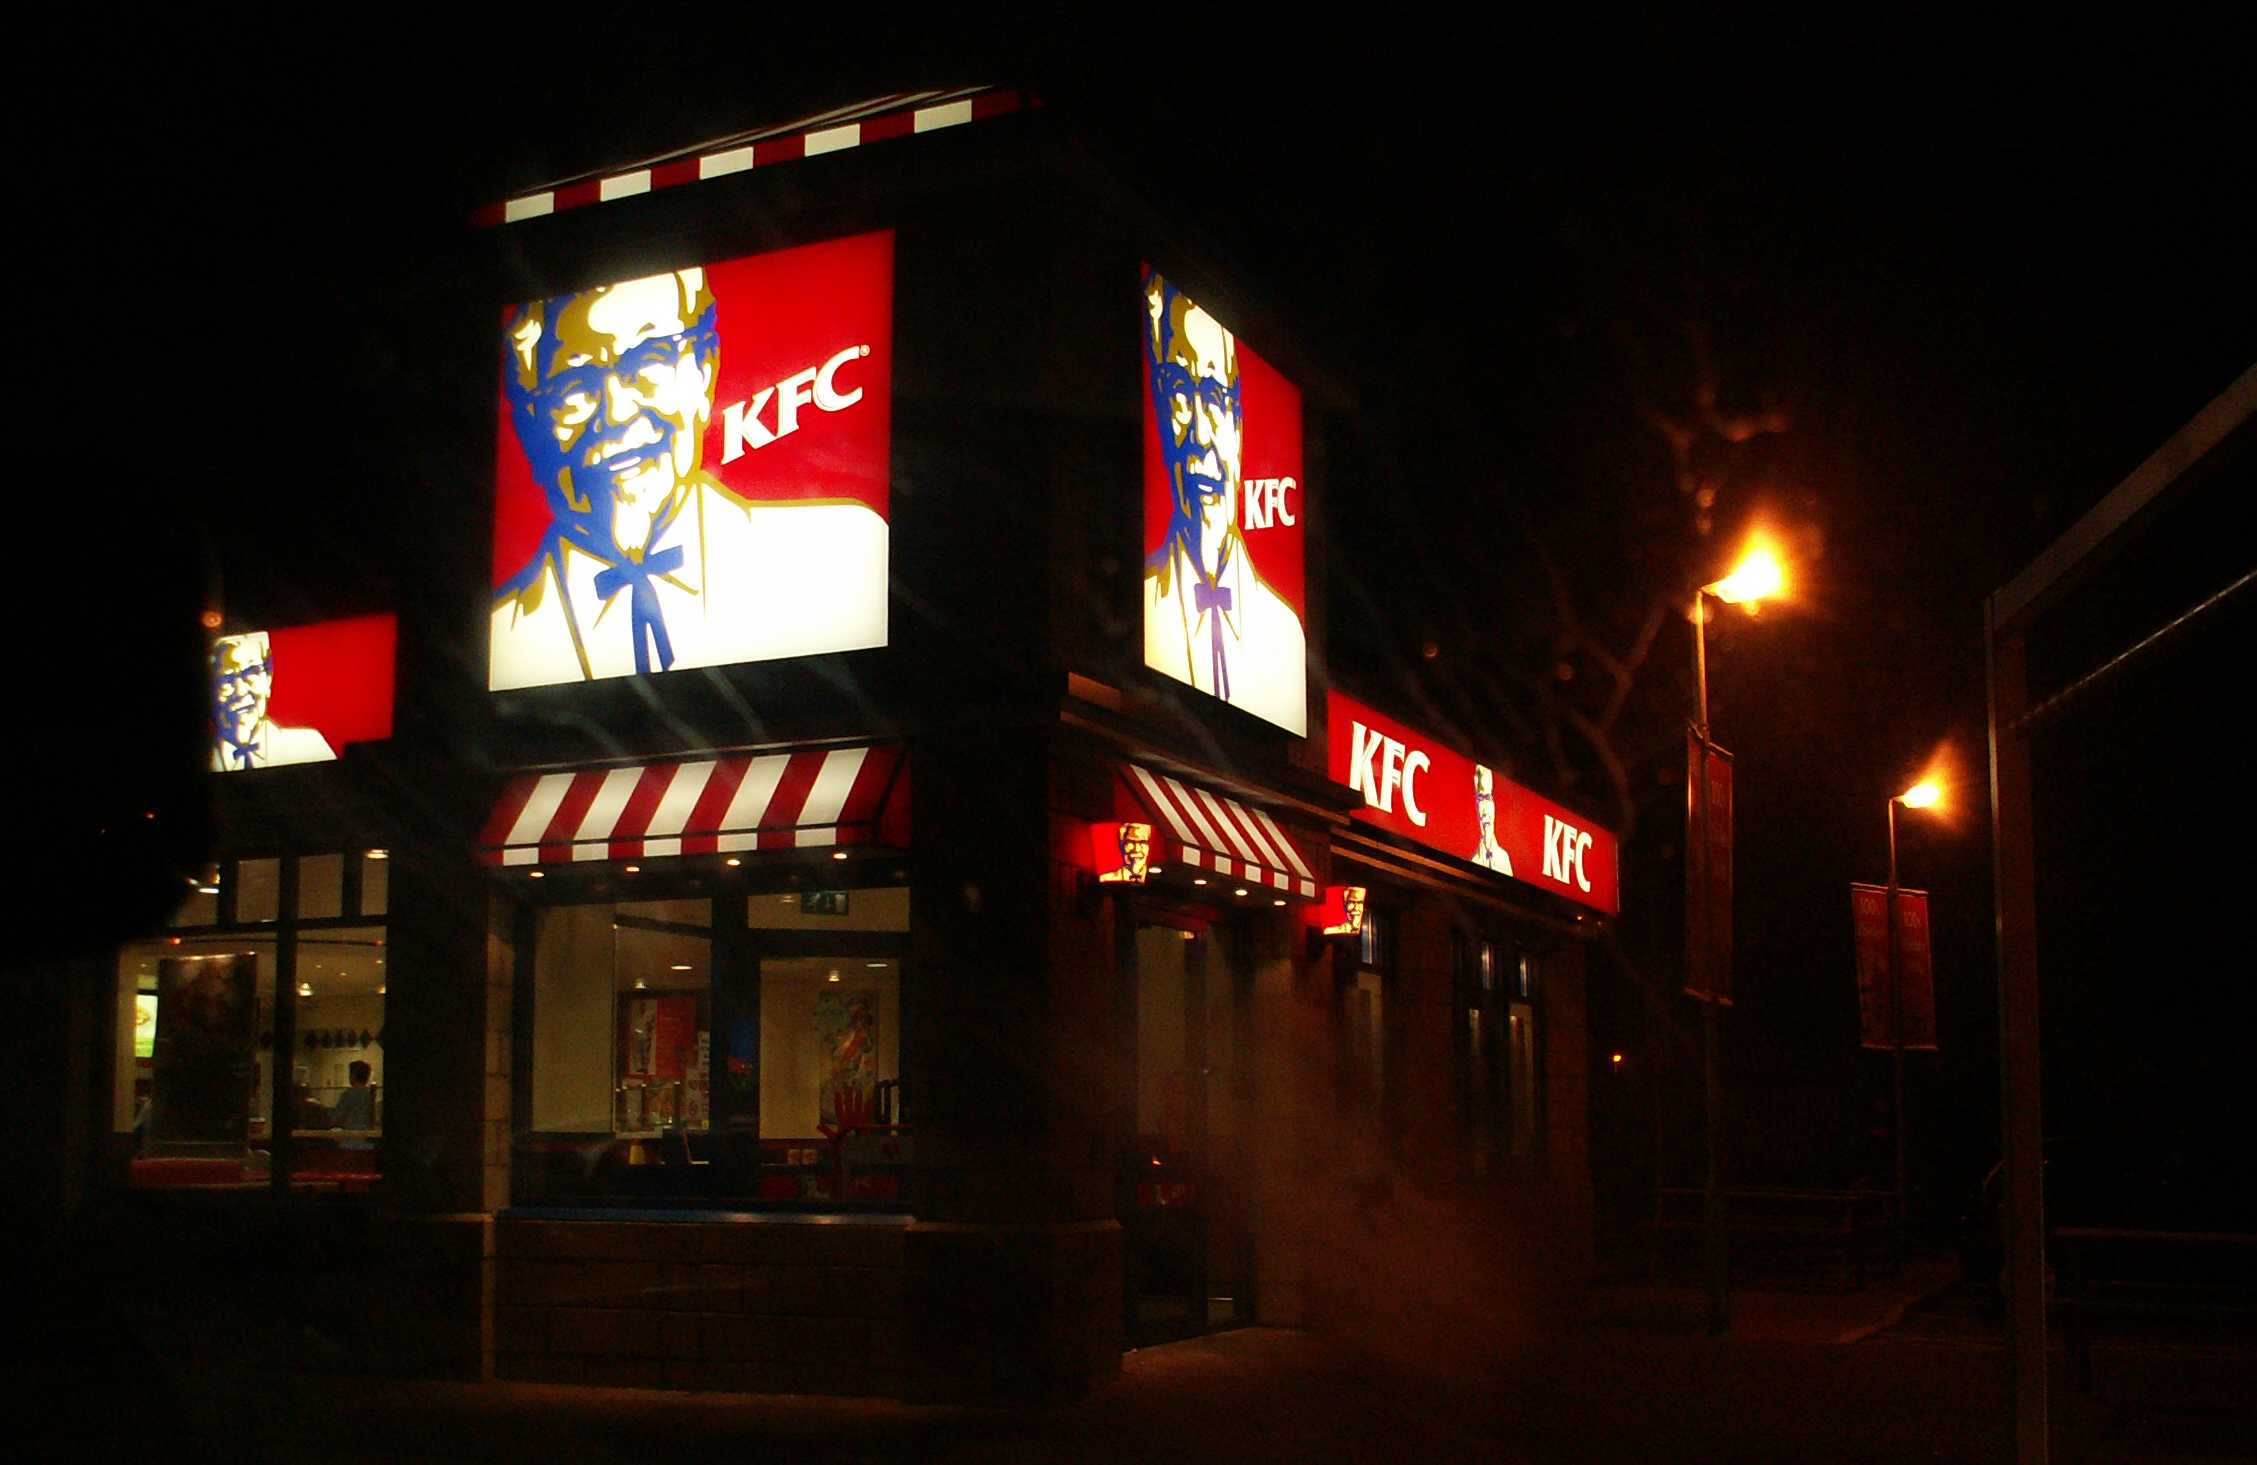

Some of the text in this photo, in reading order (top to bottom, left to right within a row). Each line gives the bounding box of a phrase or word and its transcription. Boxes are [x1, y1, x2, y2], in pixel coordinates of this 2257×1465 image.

[1244, 476, 1297, 530] KFC
[1349, 720, 1431, 827] KFC
[1542, 814, 1593, 893] KFC
